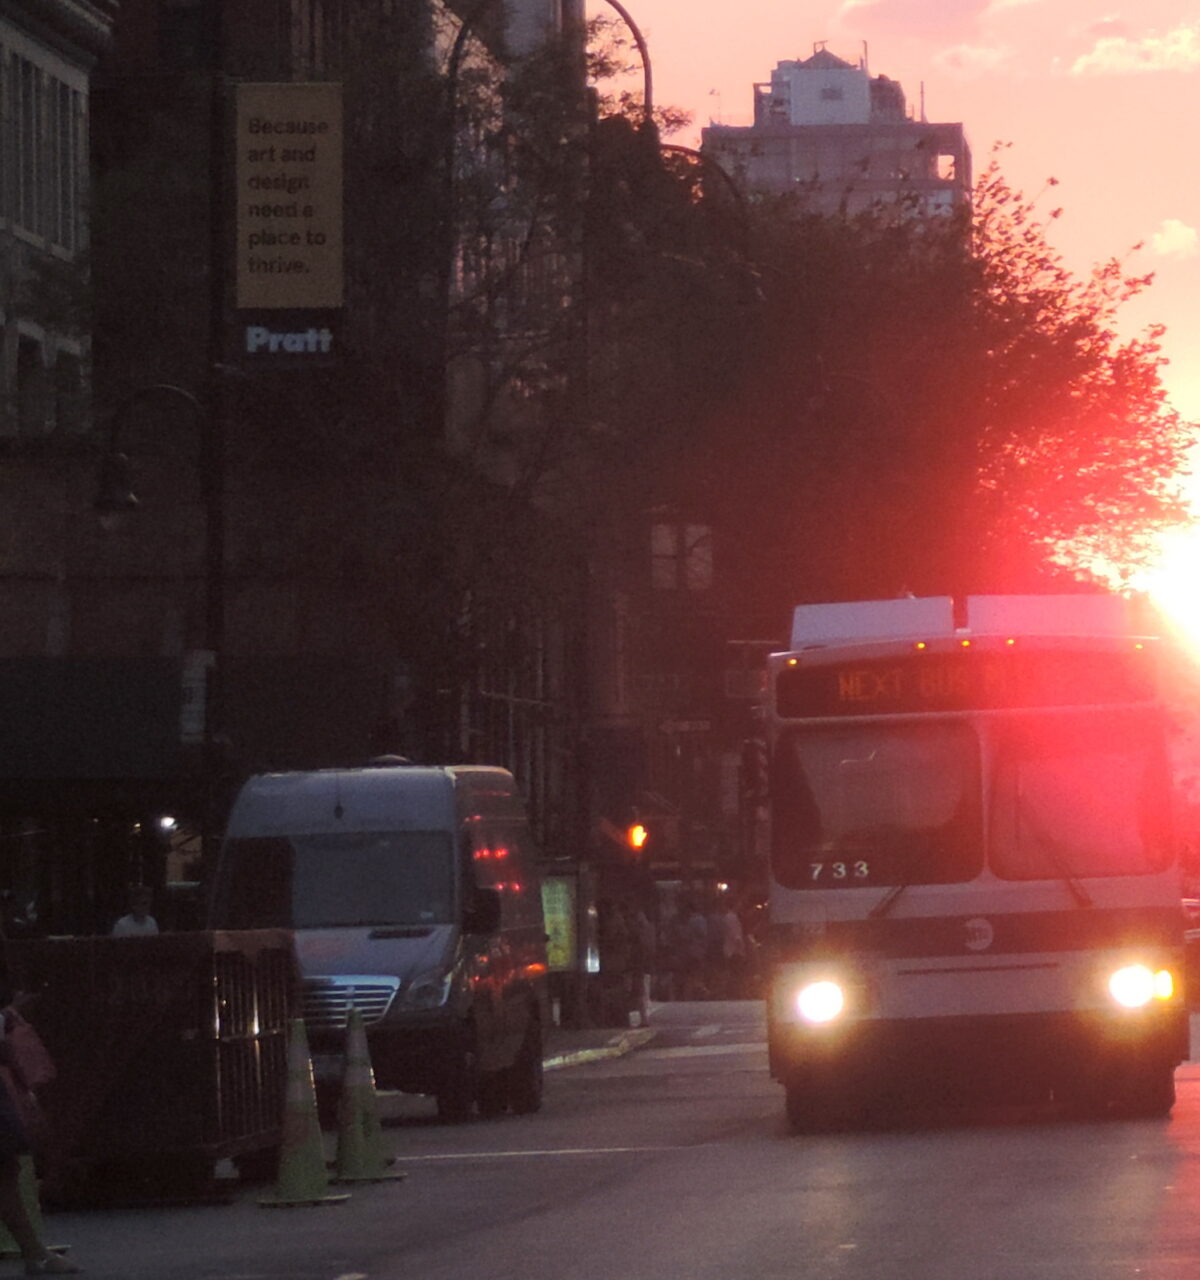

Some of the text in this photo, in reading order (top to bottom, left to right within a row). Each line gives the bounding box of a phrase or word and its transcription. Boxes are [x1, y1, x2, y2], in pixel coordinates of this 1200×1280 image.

[248, 118, 329, 135] Because
[248, 146, 316, 163] art and
[247, 173, 310, 194] design
[248, 201, 314, 218] need a
[248, 228, 327, 250] place to
[248, 257, 311, 275] thrive.
[246, 327, 333, 352] Pratt
[838, 668, 902, 702] NEXT
